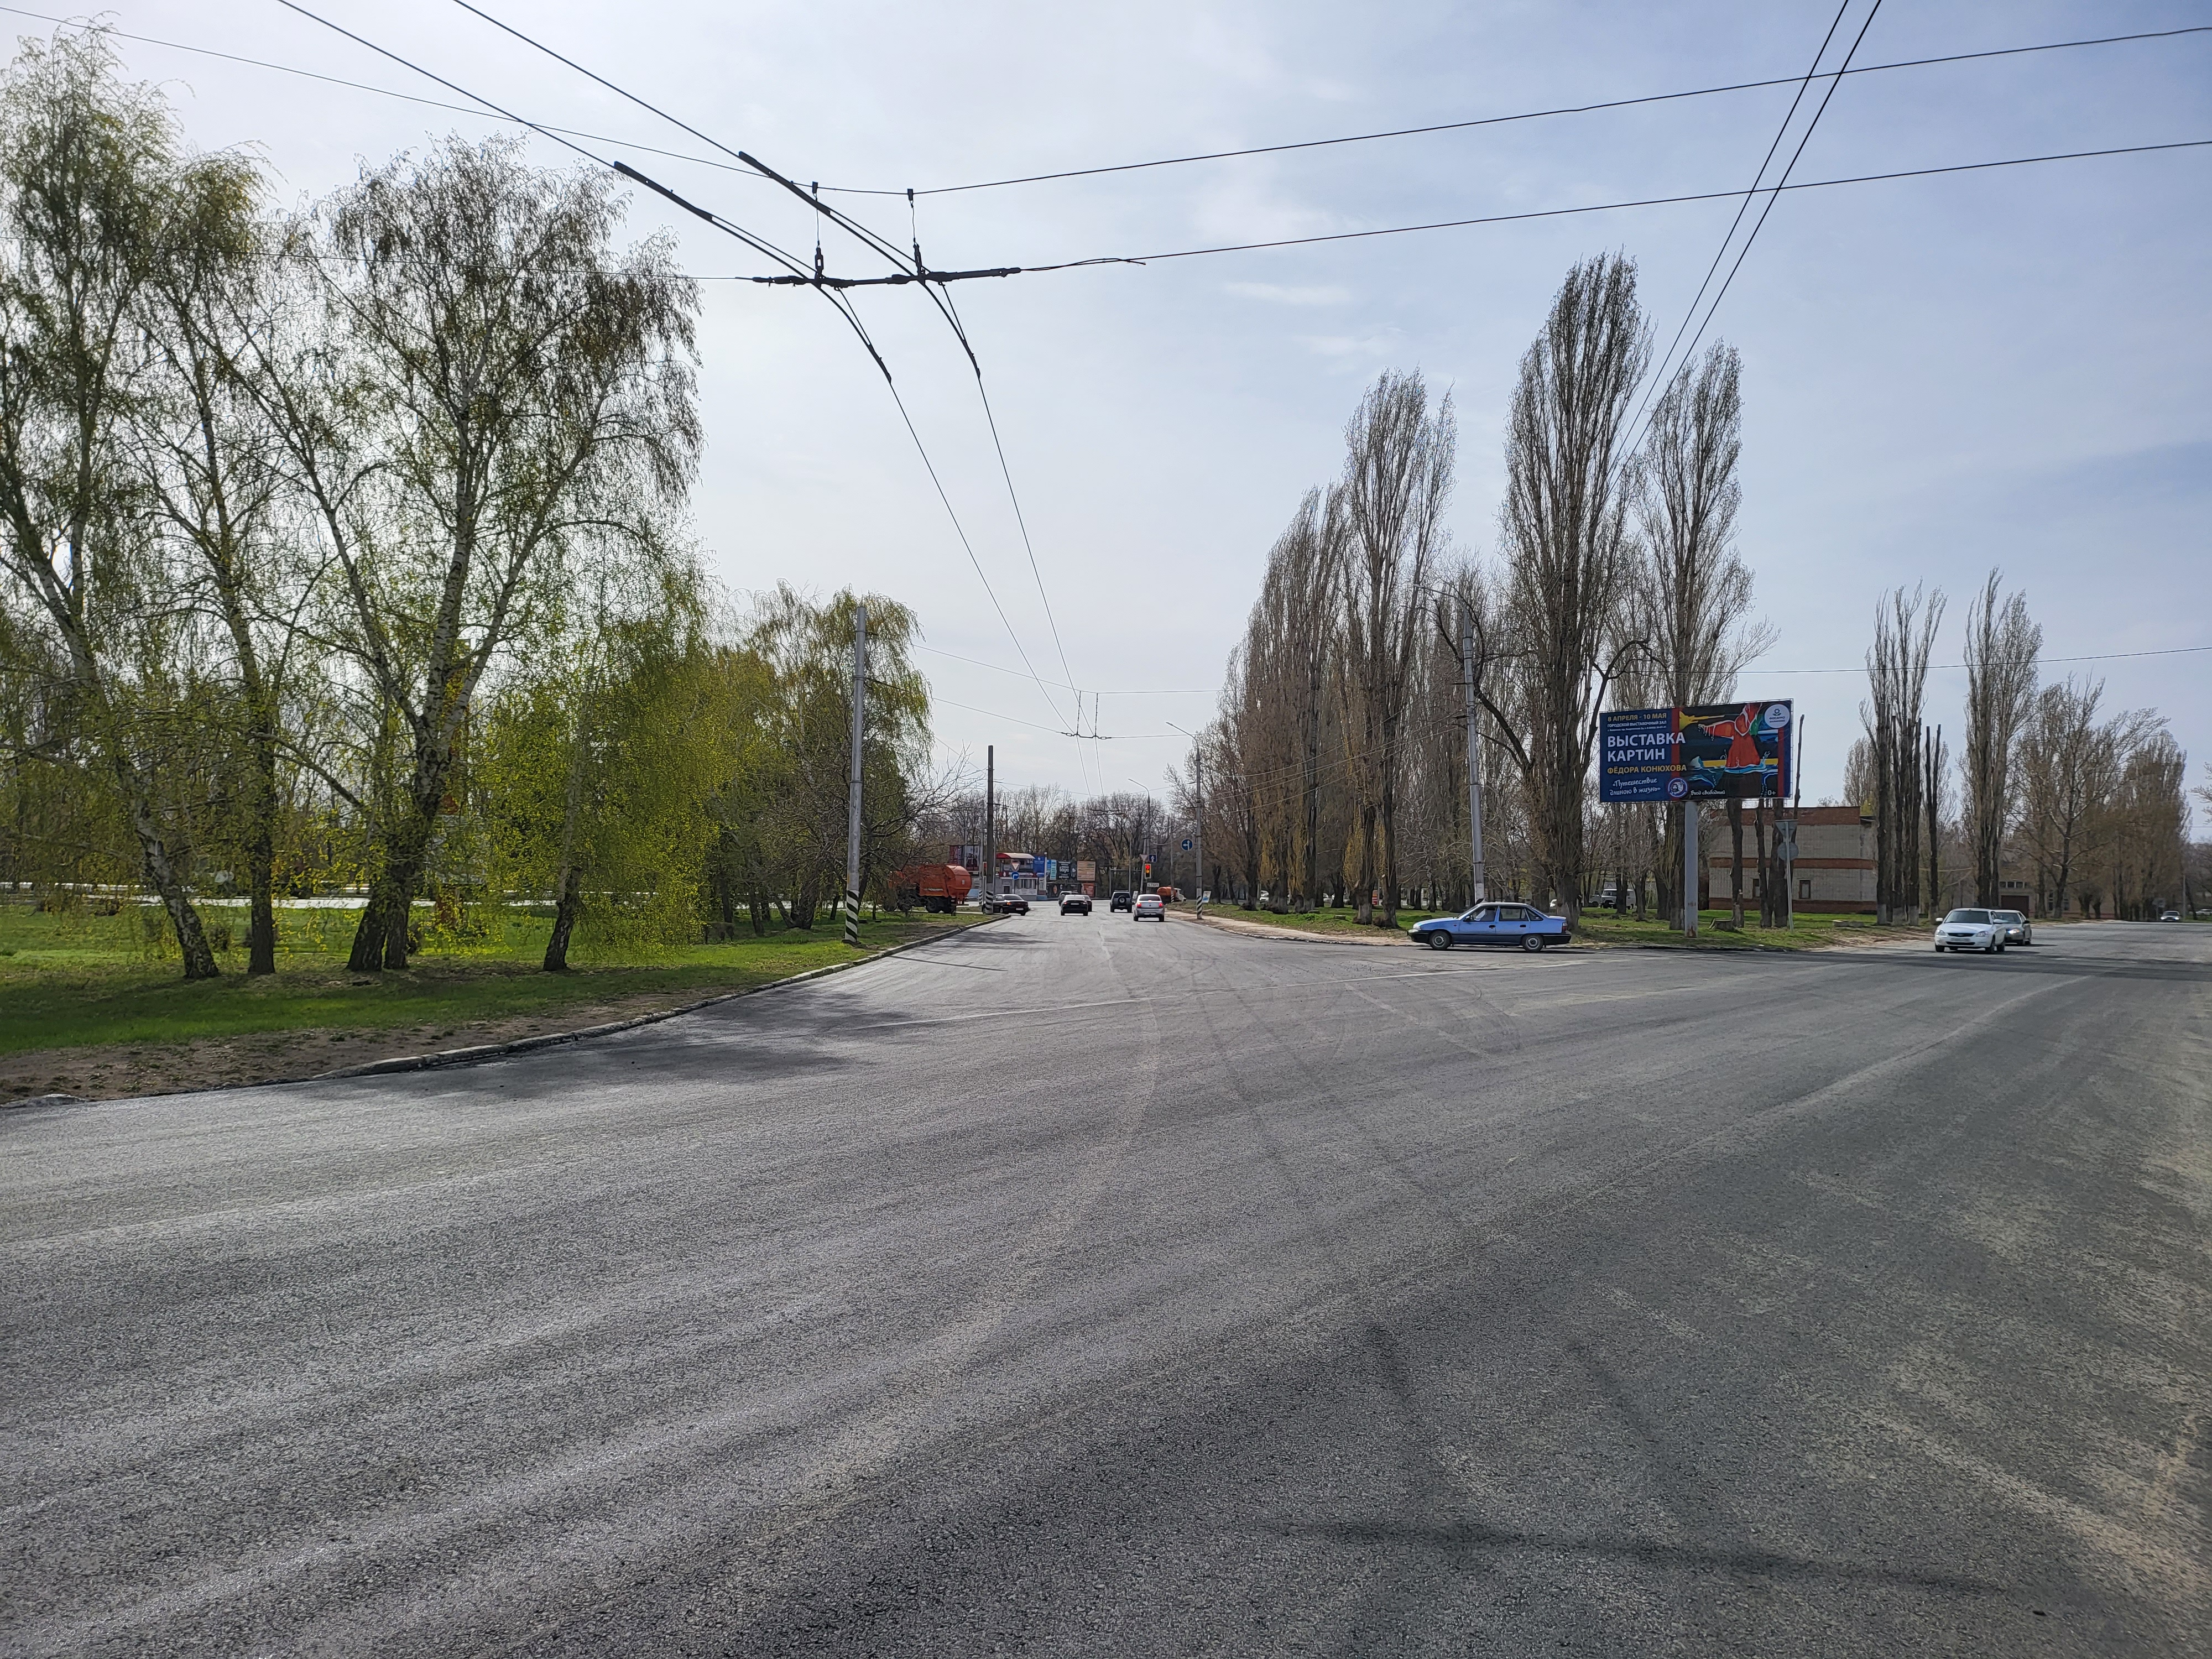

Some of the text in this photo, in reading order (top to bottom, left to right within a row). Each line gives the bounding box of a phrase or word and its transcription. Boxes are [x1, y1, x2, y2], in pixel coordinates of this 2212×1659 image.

[1608, 732, 1686, 748] ВЫСТАВКА
[1608, 748, 1665, 762] КАРТИН
[1607, 764, 1687, 775] ФЁДОРА КОНЮХОВА
[1613, 777, 1658, 790] «Путешествие
